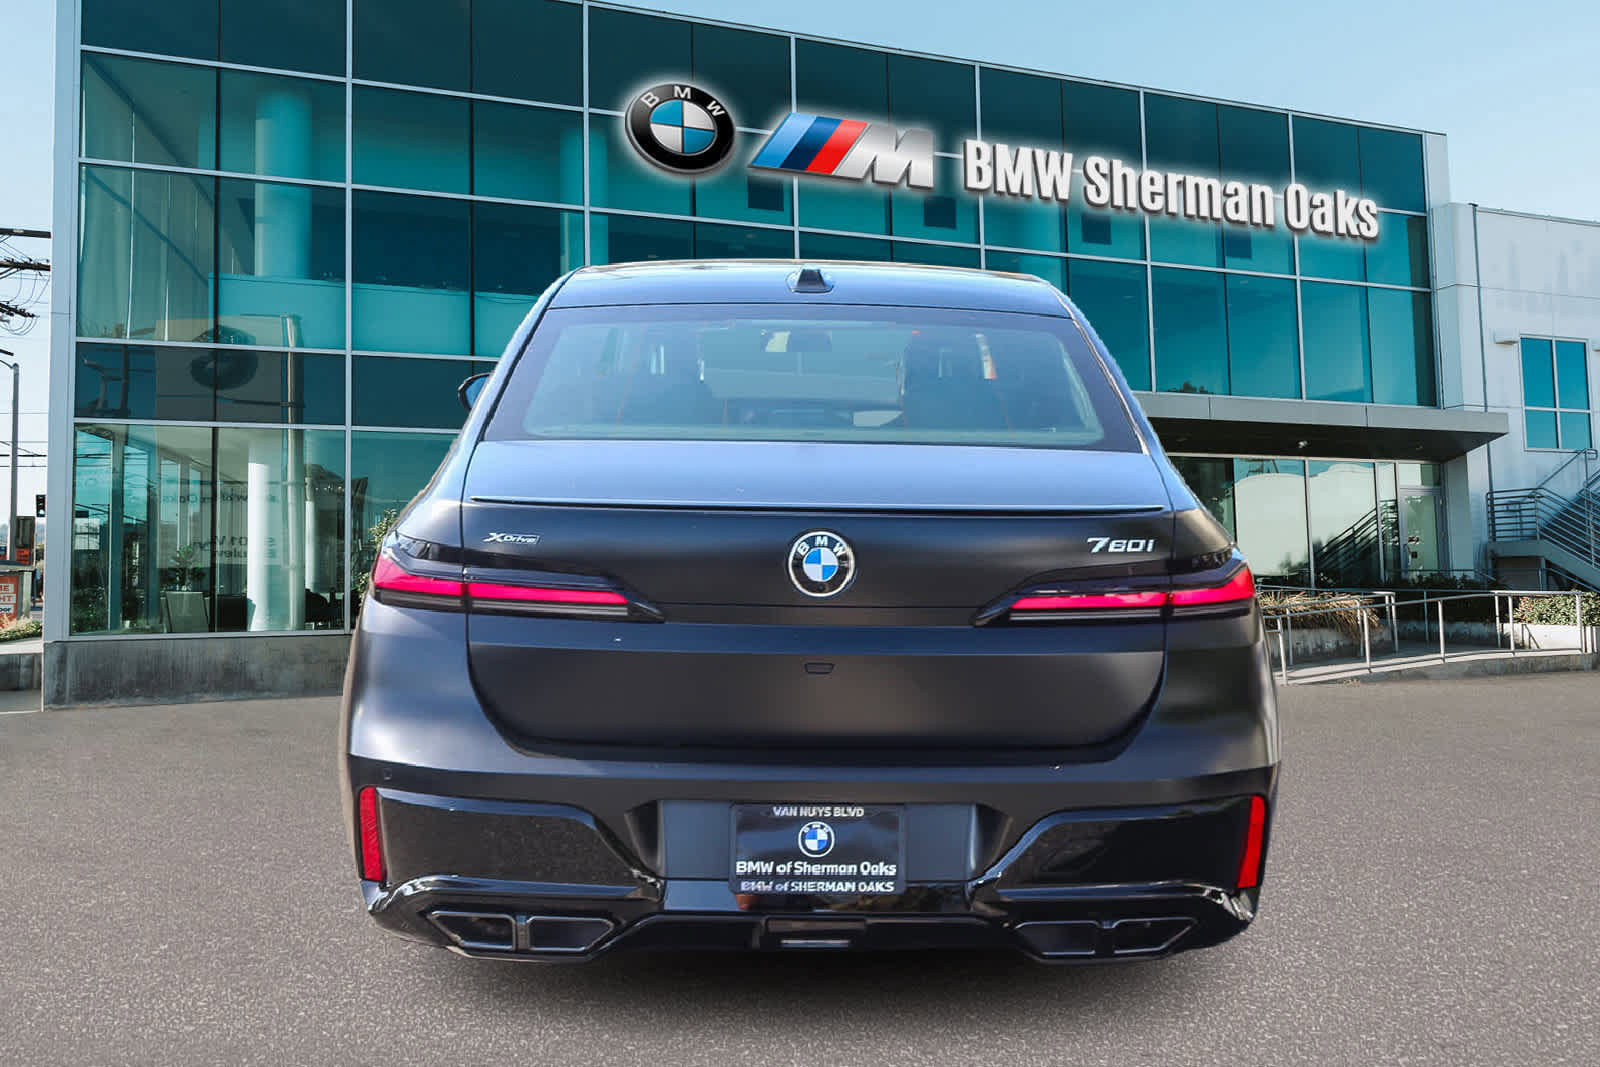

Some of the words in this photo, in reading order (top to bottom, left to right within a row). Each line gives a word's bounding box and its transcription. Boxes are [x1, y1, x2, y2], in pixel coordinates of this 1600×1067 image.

[641, 85, 724, 117] BMW
[963, 139, 1073, 202] BMW
[1083, 156, 1275, 227] Sherman
[1284, 183, 1379, 241] Oaks
[797, 535, 847, 557] BMW
[773, 806, 798, 817] VAN
[833, 806, 864, 817] BLVD
[736, 861, 774, 875] BMW
[776, 861, 793, 875] of
[793, 861, 857, 876] Sherman
[860, 861, 897, 876] Oaks
[791, 881, 856, 893] SHERMAN
[858, 881, 895, 893] OAKS
